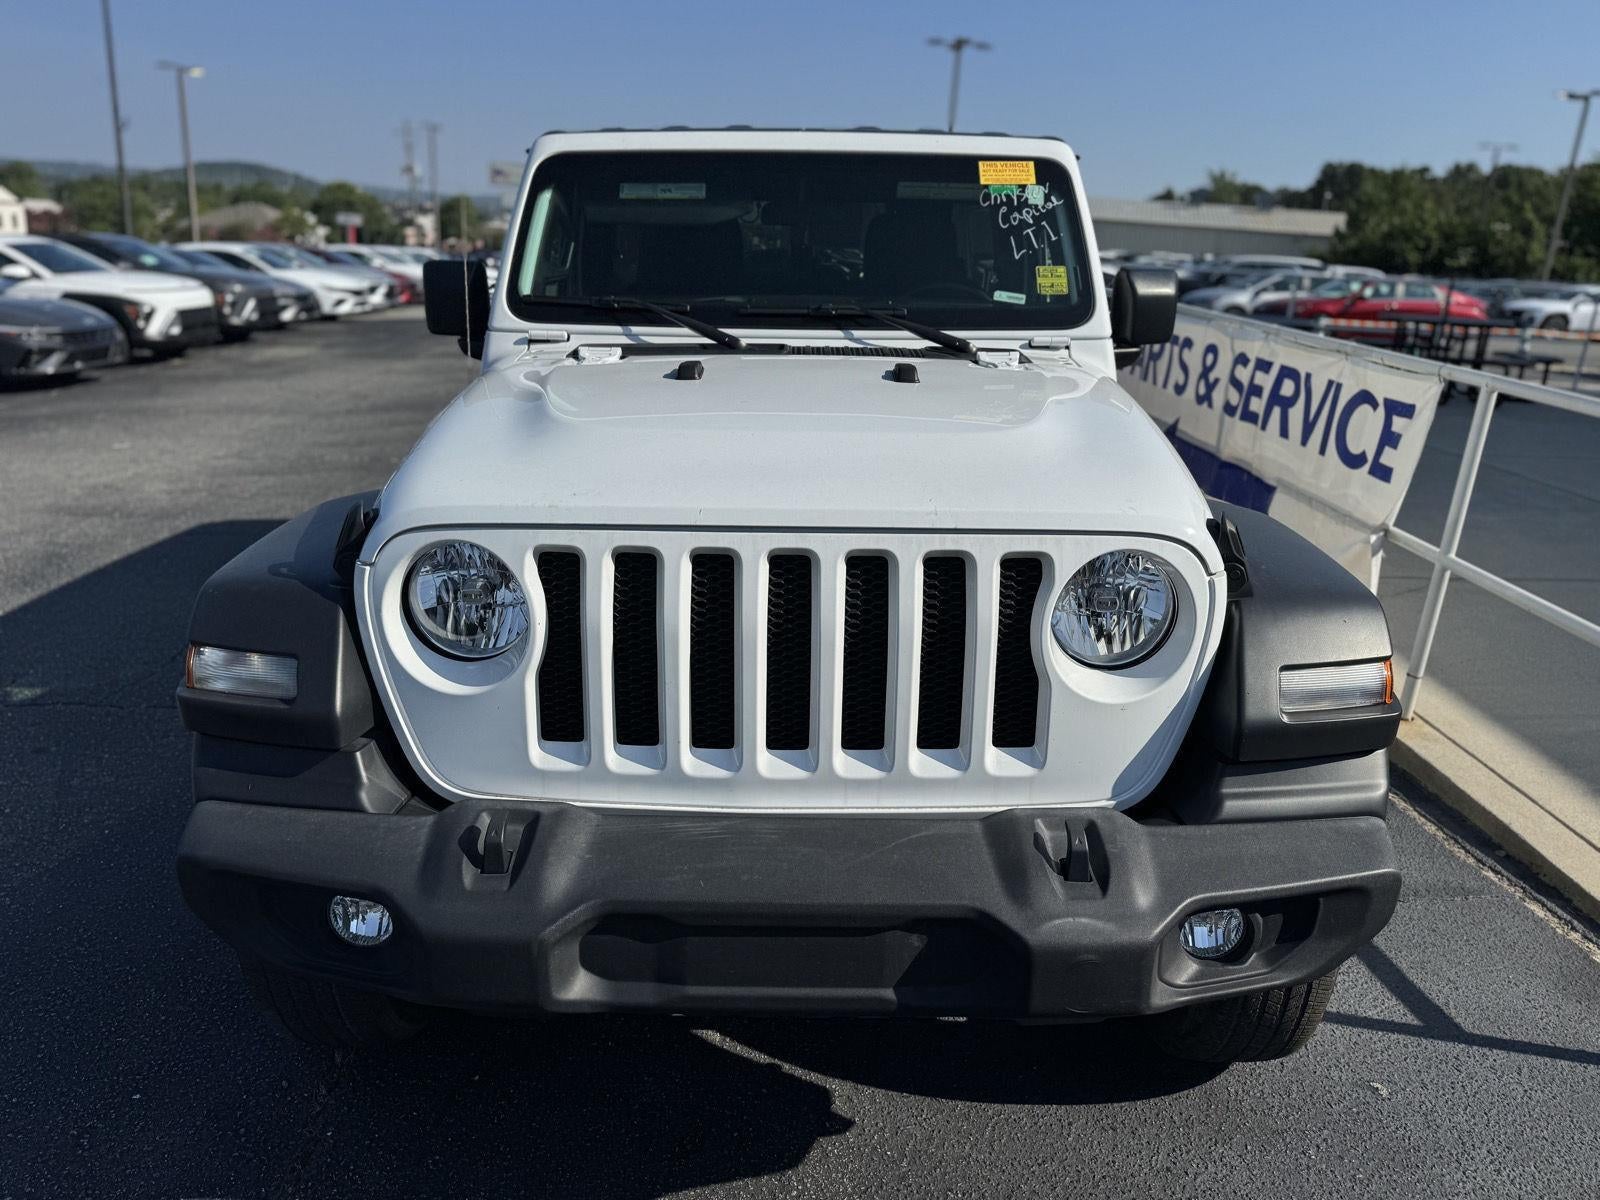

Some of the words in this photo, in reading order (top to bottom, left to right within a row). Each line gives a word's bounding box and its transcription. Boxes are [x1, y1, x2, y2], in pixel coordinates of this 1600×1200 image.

[1129, 335, 1194, 396] ARTS
[1195, 343, 1220, 409] &
[1223, 352, 1416, 484] SERVICE
